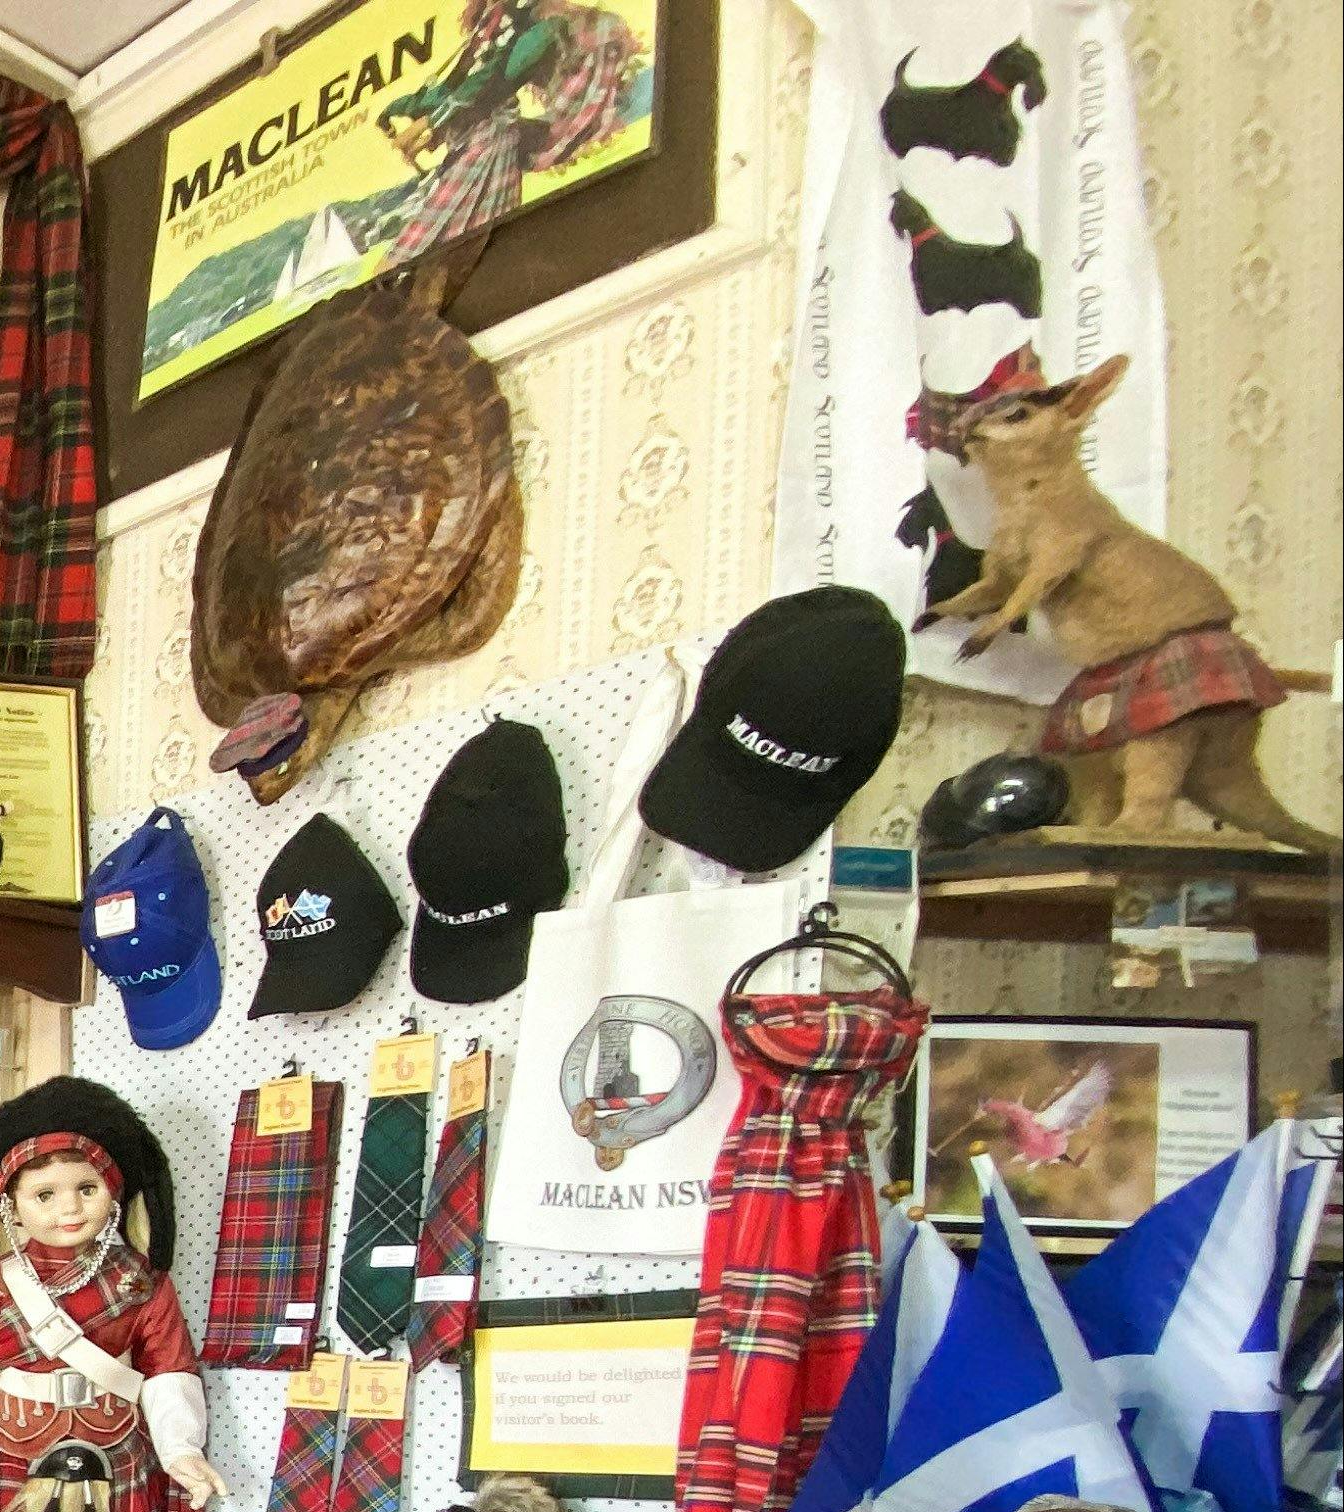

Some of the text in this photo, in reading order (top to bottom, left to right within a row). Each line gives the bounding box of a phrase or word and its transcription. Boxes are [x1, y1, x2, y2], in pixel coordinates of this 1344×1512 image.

[165, 16, 437, 222] MACLEAN
[170, 107, 371, 239] THE SCOTTISH TOWN
[183, 153, 327, 249] IN AUSTRALIA
[811, 265, 836, 379] SCOTLAND
[811, 395, 836, 508] SCOTLAND
[726, 713, 842, 773] MACLEAN
[539, 1182, 646, 1210] MACLEAN
[495, 1366, 683, 1384] We would be delighted
[495, 1390, 632, 1409] if you signed our
[495, 1412, 604, 1427] visitor's book.
